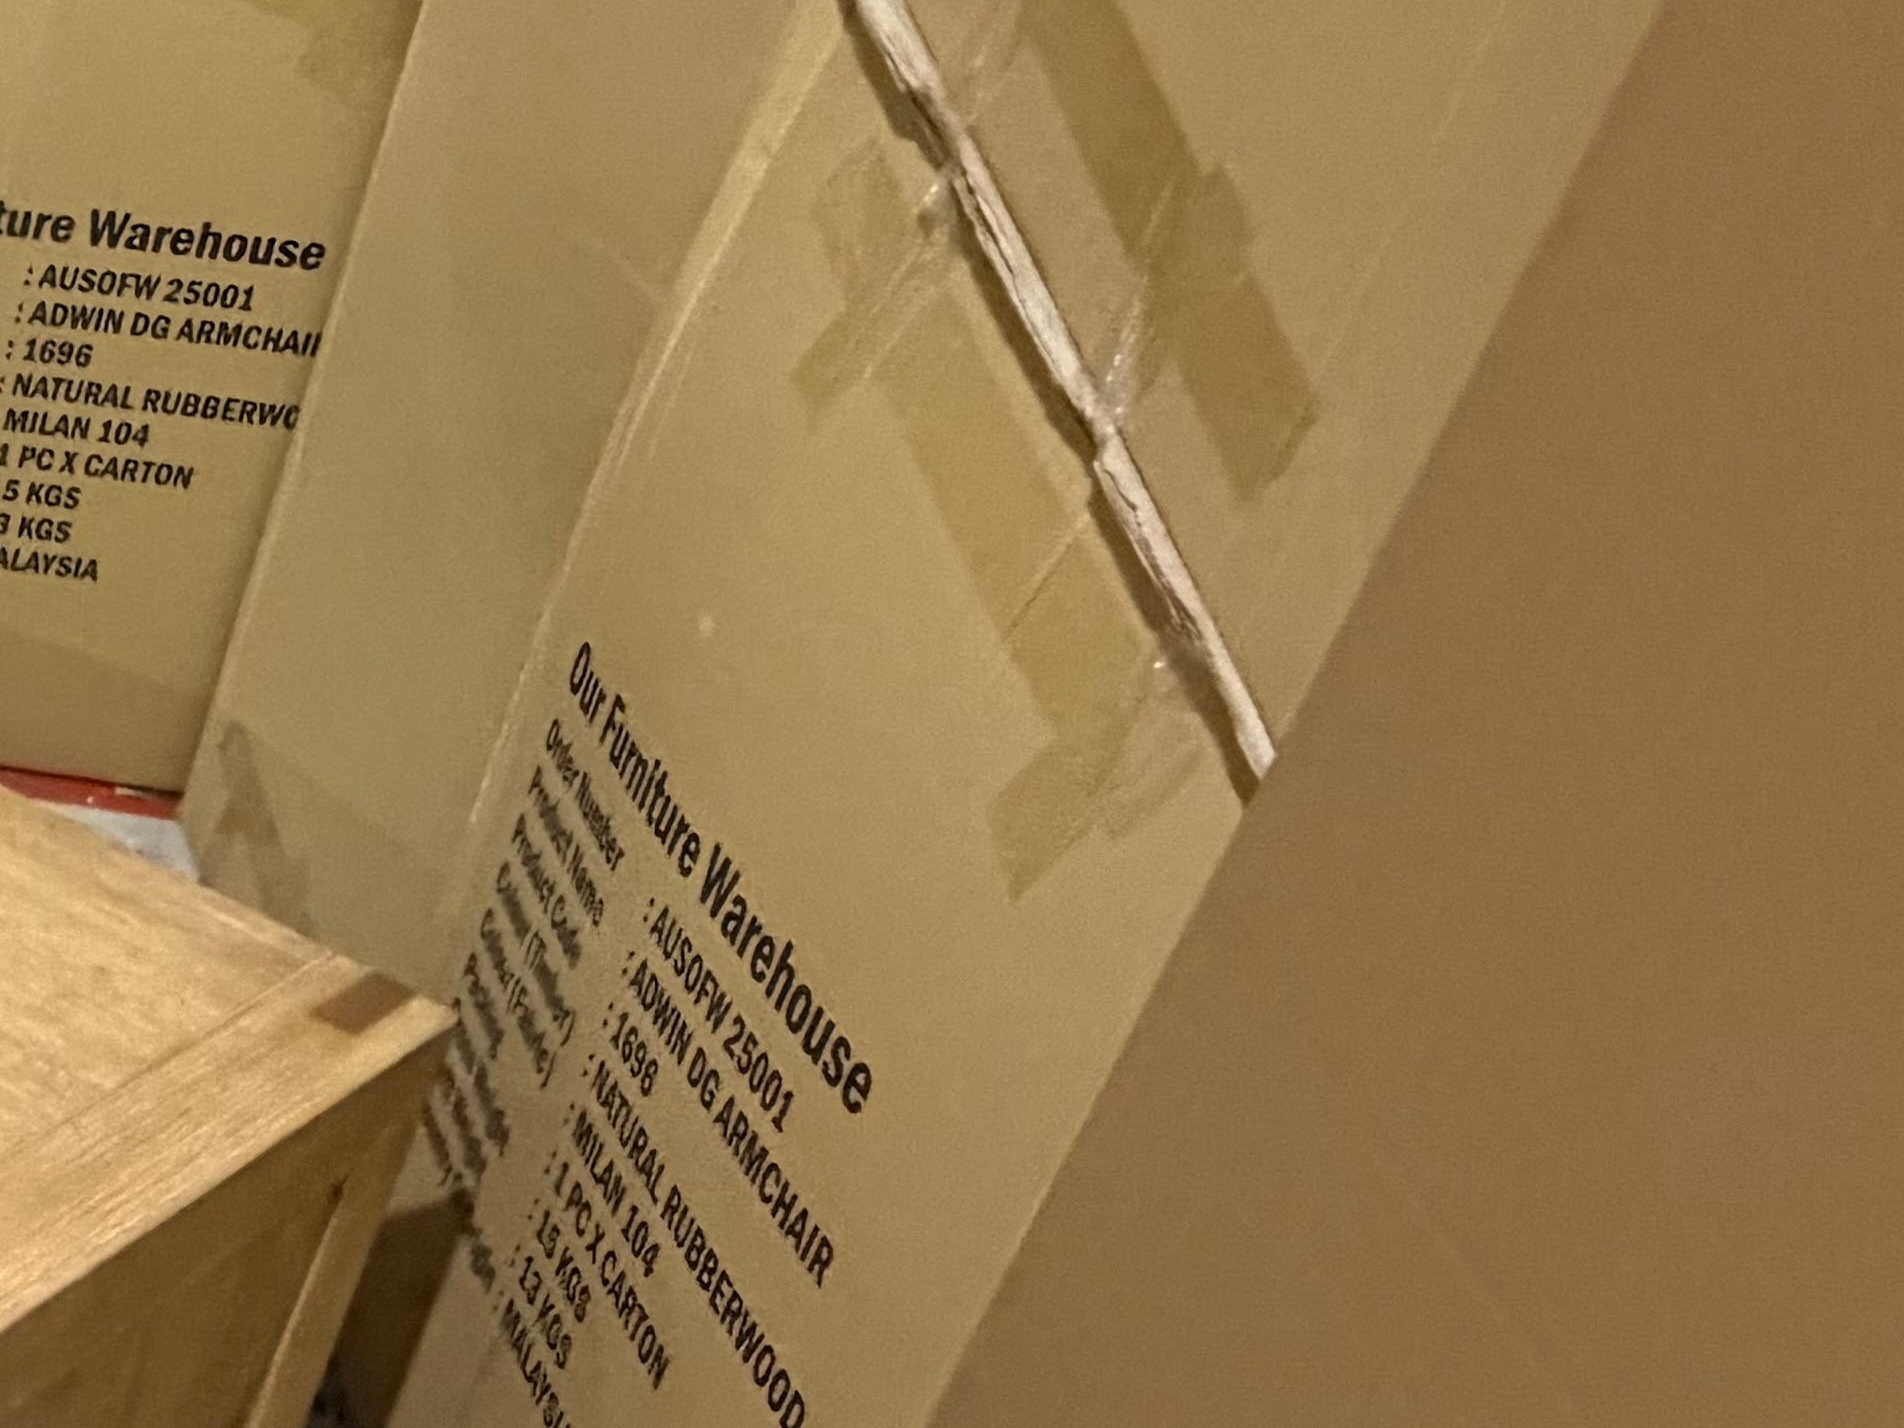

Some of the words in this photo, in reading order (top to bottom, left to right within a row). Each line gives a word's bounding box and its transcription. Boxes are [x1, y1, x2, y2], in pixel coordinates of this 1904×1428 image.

[88, 207, 326, 271] Warehouse
[28, 301, 125, 334] ADWIN
[130, 312, 171, 339] DG
[38, 264, 161, 301] AUSOFW
[162, 279, 254, 312] 25001
[16, 516, 72, 543] KGS
[569, 643, 609, 725] Our
[596, 695, 700, 875] Furniture
[703, 842, 867, 1115] Warehouse
[652, 906, 729, 1033] AUSOFW
[725, 1015, 791, 1133] 25001
[594, 1058, 662, 1205] NATURAL
